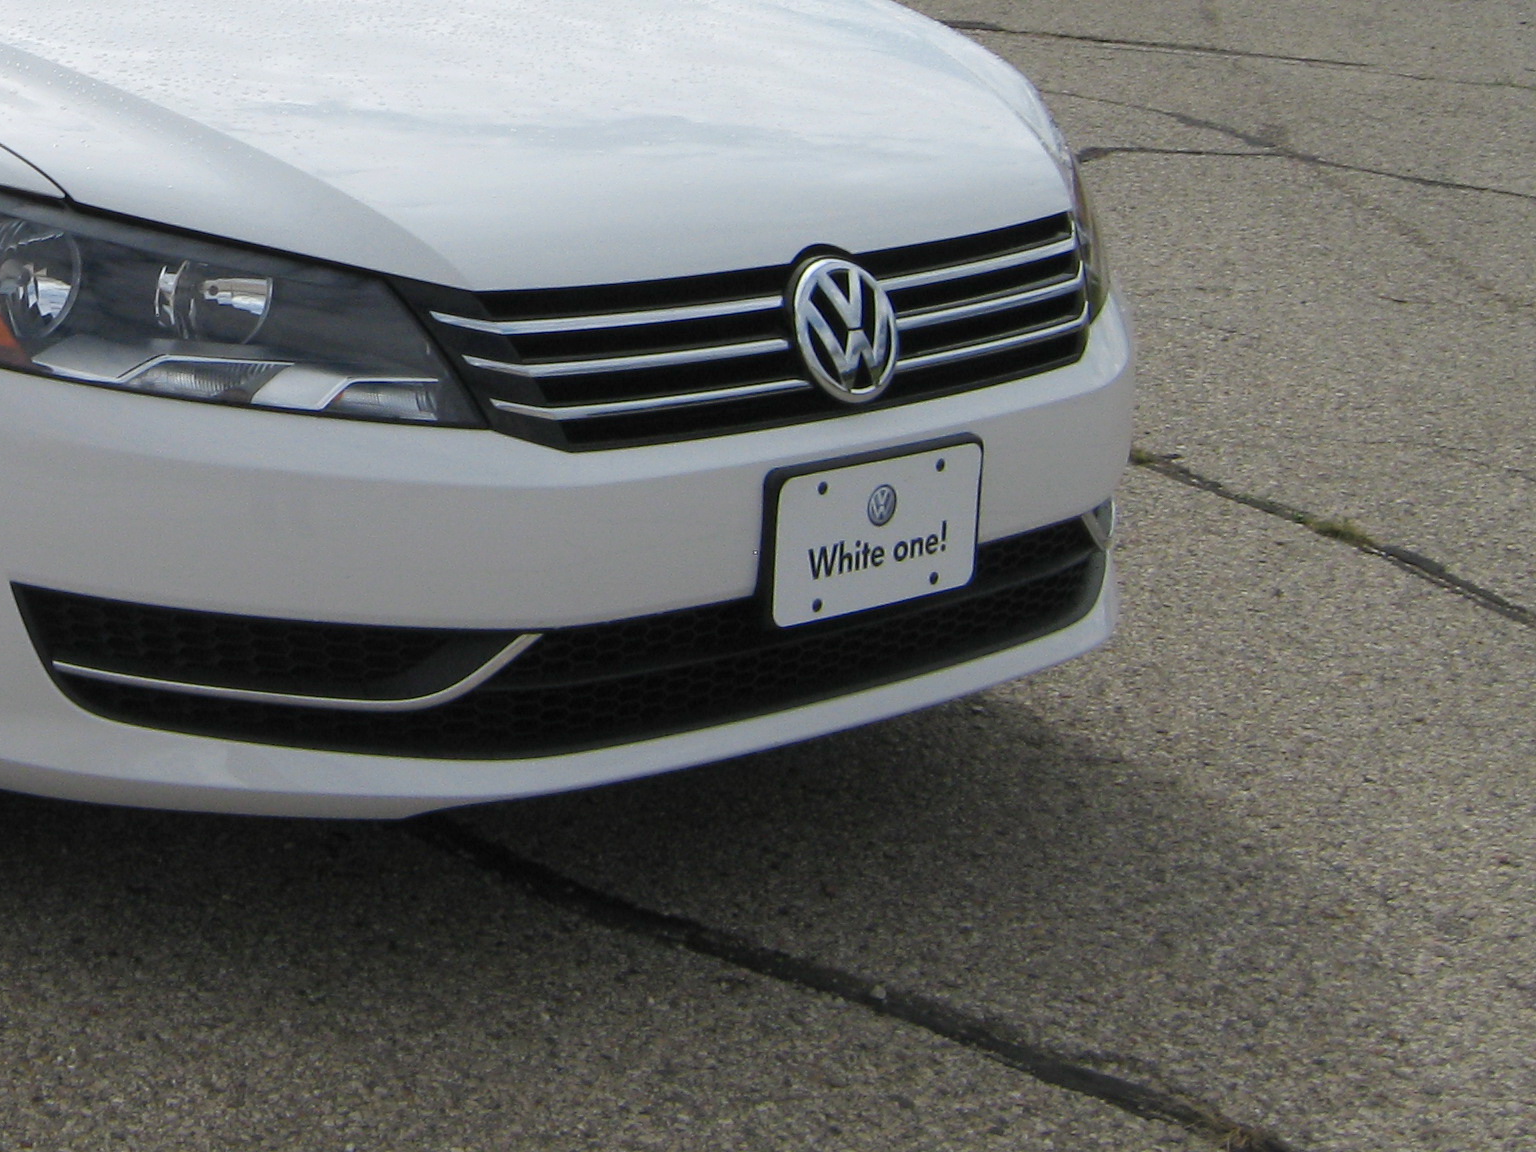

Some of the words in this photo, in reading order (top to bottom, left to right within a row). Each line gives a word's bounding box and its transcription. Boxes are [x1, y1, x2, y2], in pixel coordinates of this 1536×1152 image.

[796, 260, 897, 402] VW
[809, 541, 884, 579] White
[894, 521, 946, 561] one!
